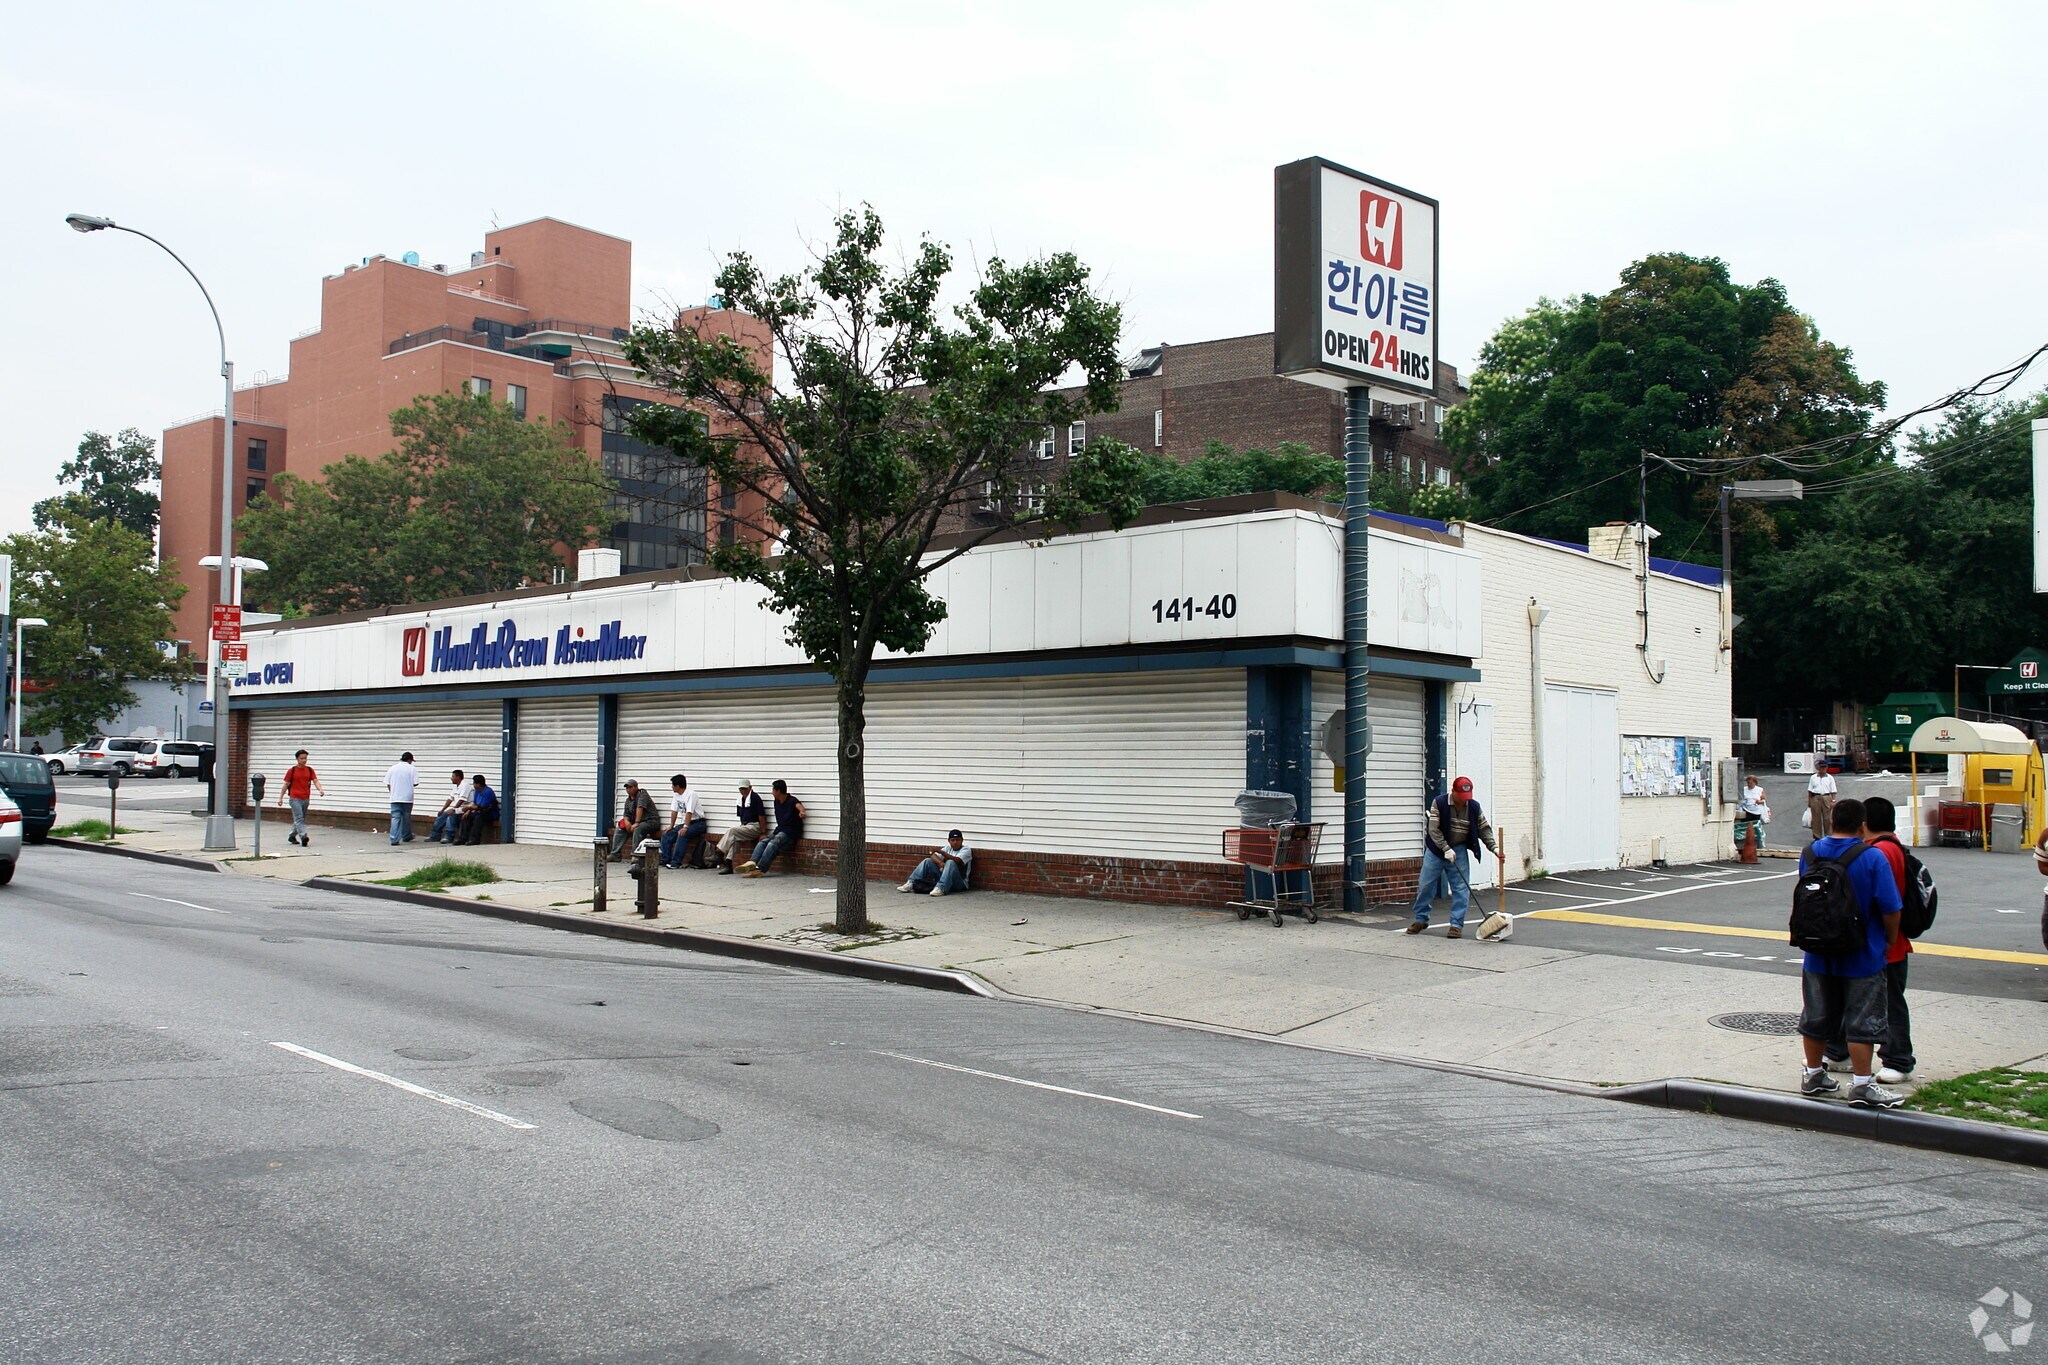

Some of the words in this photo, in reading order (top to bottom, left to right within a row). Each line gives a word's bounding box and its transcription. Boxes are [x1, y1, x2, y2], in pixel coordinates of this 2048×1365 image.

[1365, 199, 1398, 267] H
[1327, 259, 1430, 336] 한아름
[1324, 329, 1369, 365] OPEN
[1369, 330, 1399, 372] 24
[1400, 349, 1430, 381] HRS
[1152, 593, 1237, 623] 141-40
[264, 662, 293, 685] OPEN
[2003, 683, 2023, 691] Keep
